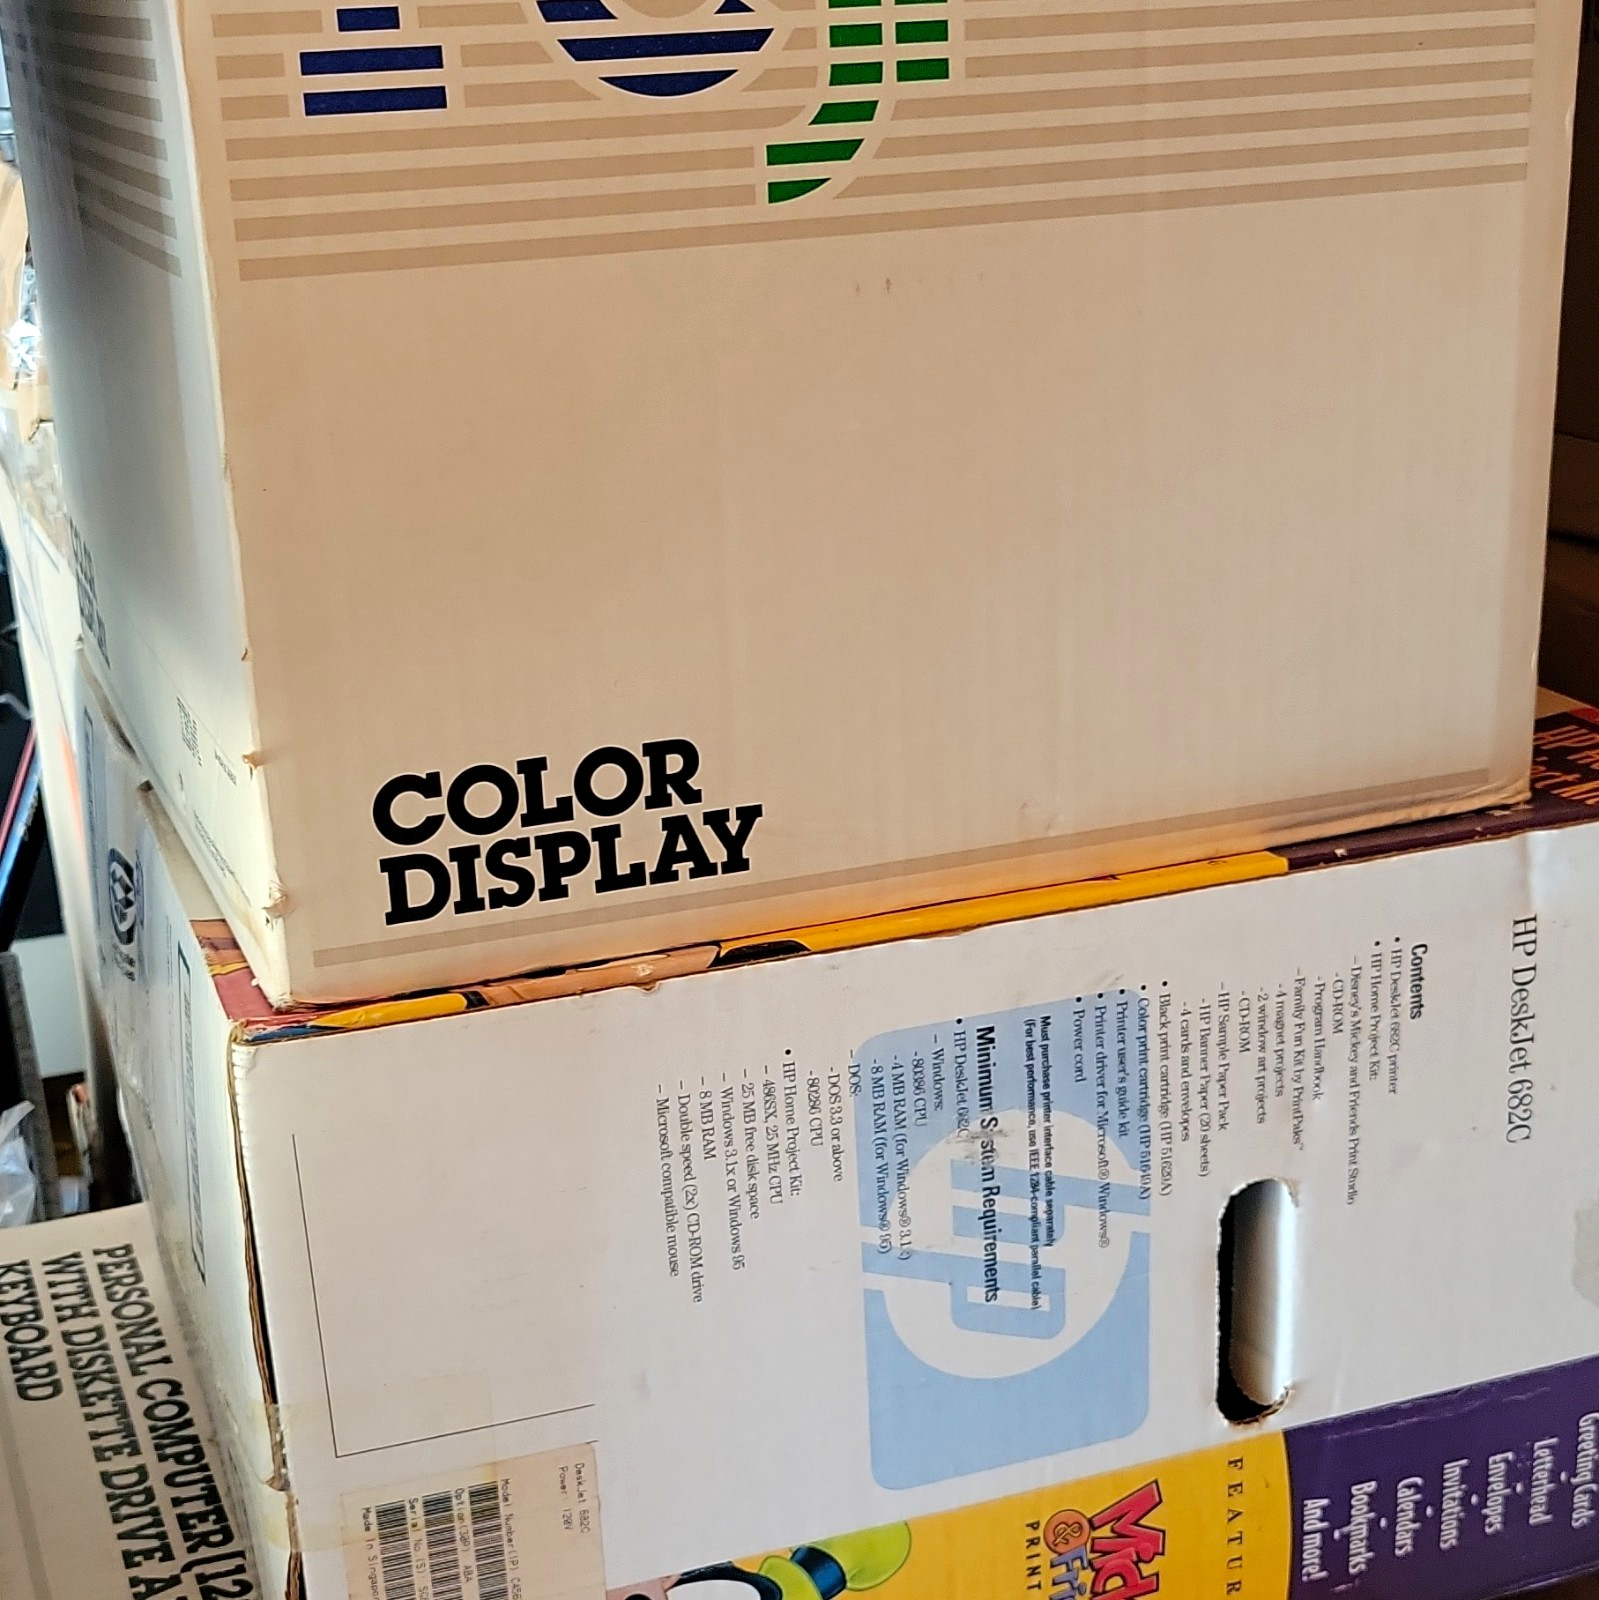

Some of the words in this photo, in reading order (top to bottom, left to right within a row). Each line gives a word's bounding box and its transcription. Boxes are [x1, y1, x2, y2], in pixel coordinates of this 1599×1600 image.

[372, 738, 703, 846] COLOR
[378, 803, 763, 926] DISPLAY
[1512, 915, 1537, 956] HP
[1371, 953, 1382, 972] HP
[1390, 949, 1402, 968] HP
[1257, 994, 1267, 1002] 2
[1293, 978, 1304, 1019] Family
[1349, 967, 1362, 1017] Disney's
[1370, 975, 1381, 1012] Home
[1389, 972, 1401, 1019] DeskJet
[1409, 944, 1428, 1019] Contents
[1137, 998, 1148, 1031] Color
[1159, 993, 1170, 1029] Black
[1200, 1005, 1210, 1024] HP
[1218, 992, 1229, 1012] HP
[1313, 983, 1324, 1036] Program
[1332, 980, 1343, 1035] CD-ROM
[1508, 964, 1537, 1074] DeskJet
[1024, 1019, 1036, 1037] (For
[1040, 1016, 1051, 1040] Must
[1073, 1009, 1085, 1051] Power
[1095, 1006, 1107, 1049] Printer
[1116, 1002, 1128, 1044] Printer
[1181, 1019, 1191, 1052] cards
[1216, 1015, 1229, 1060] Sample
[1238, 998, 1250, 1054] CD-ROM
[1256, 1004, 1267, 1053] window
[1274, 1001, 1285, 1047] magnet
[1294, 1022, 1304, 1047] Fun
[1348, 1020, 1361, 1062] Mickey
[1368, 1015, 1381, 1057] Project
[954, 1031, 966, 1052] HP
[1026, 1041, 1036, 1061] best
[1135, 1034, 1149, 1064] print
[1157, 1032, 1170, 1061] print
[1200, 1028, 1210, 1072] Banner
[1294, 1050, 1304, 1066] Kit
[782, 1062, 795, 1083] HP
[848, 1064, 861, 1097] DOS:
[912, 1058, 924, 1096] 80386
[932, 1048, 944, 1111] Windows:
[954, 1055, 967, 1105] DeskJet
[976, 1026, 996, 1112] Minimum
[1039, 1043, 1052, 1089] purchase
[1074, 1054, 1086, 1083] cord
[1096, 1052, 1108, 1088] driver
[1117, 1048, 1129, 1083] user's
[1181, 1056, 1192, 1078] and
[1217, 1062, 1229, 1098] Paper
[1256, 1057, 1266, 1072] art
[1273, 1049, 1285, 1097] projects
[1292, 1069, 1304, 1083] by
[1312, 1039, 1324, 1100] Handbook
[1349, 1066, 1360, 1088] and
[1370, 1060, 1380, 1080] Kit:
[1387, 1055, 1399, 1094] printer
[742, 1083, 754, 1098] 25
[807, 1078, 820, 1115] 80286
[828, 1074, 841, 1104] DOS
[871, 1076, 884, 1100] MB
[892, 1072, 904, 1096] MB
[1024, 1064, 1038, 1128] performance,
[1097, 1091, 1108, 1108] for
[1115, 1086, 1129, 1118] guide
[1136, 1068, 1150, 1122] cartridge
[1157, 1065, 1172, 1118] cartridge
[1198, 1075, 1210, 1110] Paper
[1255, 1076, 1266, 1124] projects
[677, 1094, 692, 1141] Double
[700, 1101, 713, 1124] MB
[720, 1087, 734, 1147] Windows
[743, 1101, 756, 1124] MB
[784, 1086, 797, 1124] Home
[829, 1106, 842, 1125] 3.3
[873, 1102, 885, 1134] RAM
[893, 1098, 906, 1131] RAM
[914, 1098, 927, 1126] CPU
[1040, 1092, 1054, 1122] printer
[1179, 1081, 1192, 1142] envelopes
[1198, 1112, 1210, 1132] (20
[1218, 1100, 1229, 1131] Pack
[1348, 1091, 1360, 1135] Friends
[1506, 1079, 1533, 1143] 682C
[656, 1098, 673, 1161] Microsoft
[702, 1127, 715, 1160] RAM
[744, 1126, 757, 1151] free
[766, 1126, 778, 1141] 25
[810, 1118, 822, 1146] CPU
[830, 1128, 841, 1142] or
[893, 1133, 907, 1156] (for
[1028, 1130, 1038, 1147] use
[1043, 1125, 1055, 1168] interface
[1119, 1121, 1130, 1137] kit
[1138, 1124, 1150, 1148] (HP
[1160, 1121, 1172, 1145] (HP
[678, 1144, 695, 1182] speed
[724, 1149, 738, 1176] 3.1x
[767, 1143, 779, 1173] MHz
[784, 1128, 800, 1172] Project
[832, 1144, 844, 1182] above
[872, 1136, 887, 1160] (for
[979, 1117, 998, 1182] Sstem
[1029, 1149, 1040, 1169] IEEE
[1198, 1134, 1210, 1177] sheets)
[1347, 1139, 1359, 1165] Print
[747, 1154, 759, 1180] disk
[1044, 1170, 1055, 1196] cable
[659, 1163, 677, 1232] compatible
[682, 1184, 698, 1210] (2x)
[727, 1179, 736, 1192] or
[745, 1183, 761, 1219] space
[768, 1176, 782, 1204] CPU
[788, 1175, 802, 1196] Kit:
[1346, 1168, 1358, 1204] Studio
[686, 1213, 702, 1269] CD-ROM
[727, 1194, 742, 1253] Windows
[1042, 1199, 1055, 1247] separately
[667, 1235, 681, 1277] mouse
[877, 1233, 892, 1254] 95)
[978, 1186, 1000, 1303] Requirements
[732, 1255, 744, 1270] 95
[1029, 1245, 1040, 1279] parallel
[42, 1251, 103, 1322] WITH
[690, 1271, 704, 1302] drive
[1030, 1282, 1041, 1310] cable)
[0, 1259, 64, 1401] KEYBOARD
[61, 1325, 142, 1462] DISKETTE
[92, 1243, 173, 1377] PERSONAL
[136, 1378, 234, 1553] COMPUTER
[1570, 1412, 1599, 1484] Greeting
[501, 1478, 512, 1507] Model
[574, 1463, 586, 1503] DeskJet
[1482, 1452, 1514, 1534] Envelopes
[1528, 1438, 1560, 1526] Letterhead
[99, 1463, 174, 1569] DRIVE
[362, 1507, 372, 1532] Made
[408, 1498, 423, 1531] Serial
[1302, 1498, 1331, 1532] And
[1395, 1477, 1424, 1556] Calendars
[1440, 1459, 1469, 1550] Invitations
[1572, 1484, 1597, 1528] Cards
[1227, 1457, 1243, 1595] FEATUR
[1345, 1481, 1377, 1574] Bookmarks
[1026, 1520, 1040, 1590] PRINT
[1302, 1533, 1328, 1582] more!
